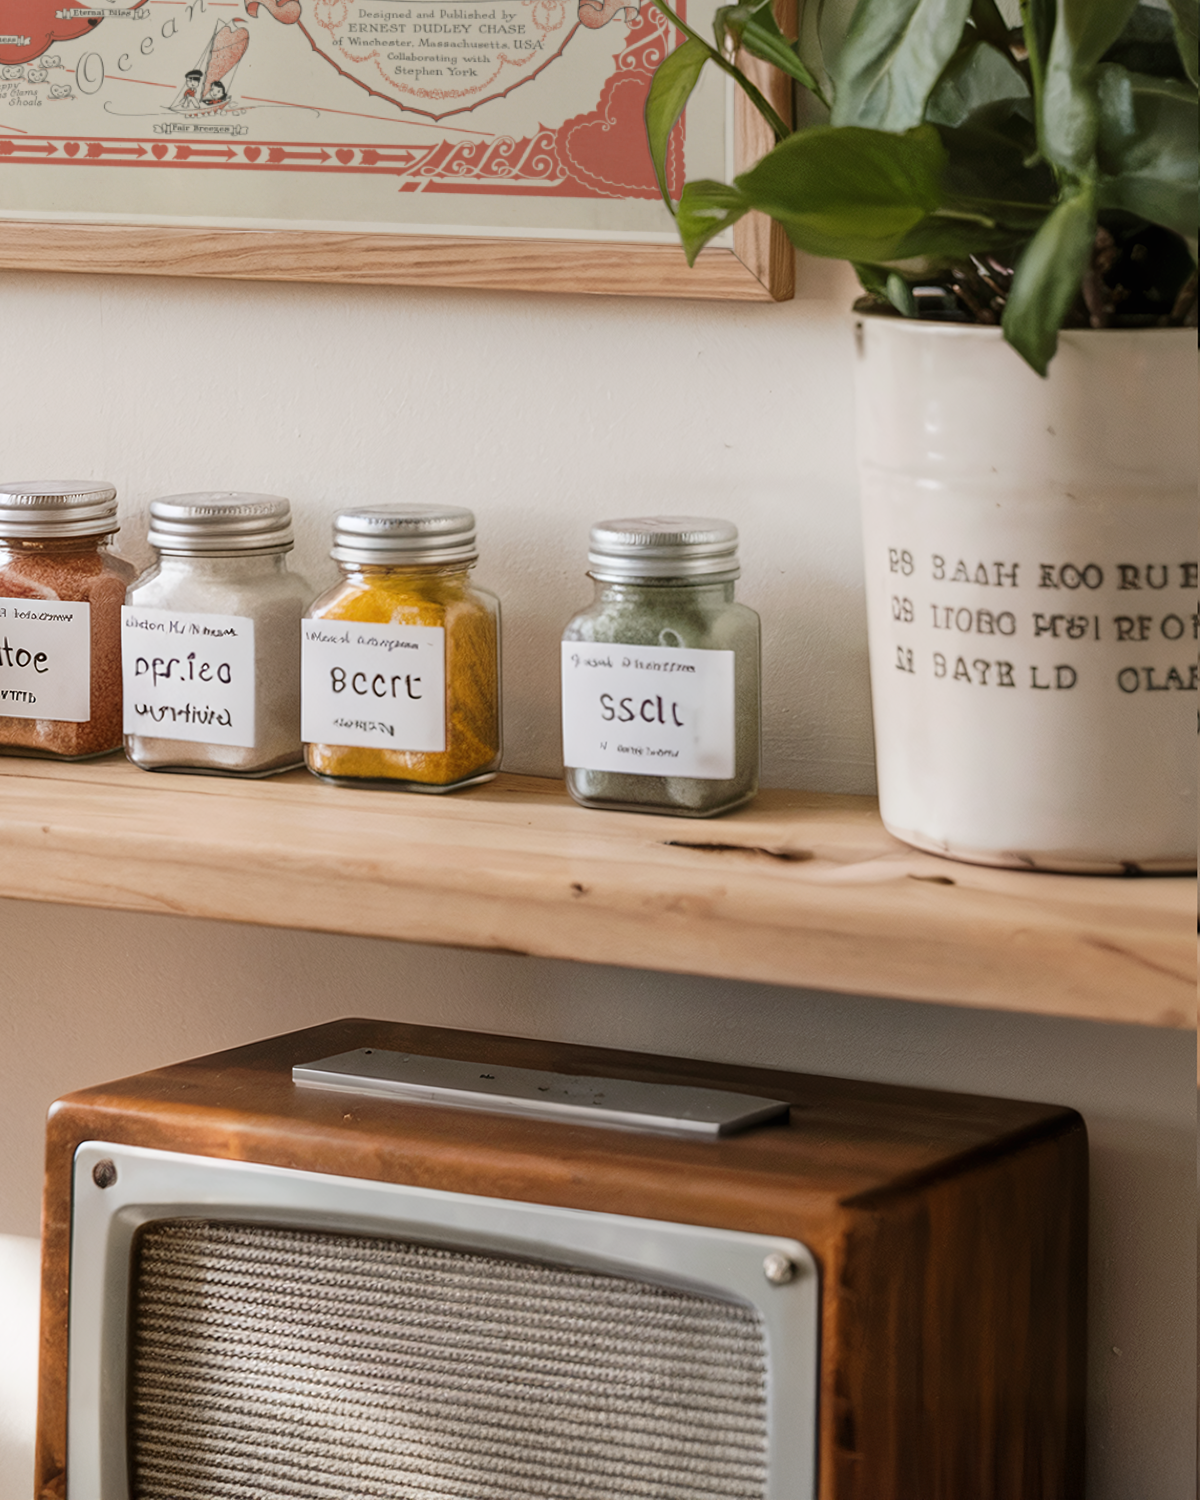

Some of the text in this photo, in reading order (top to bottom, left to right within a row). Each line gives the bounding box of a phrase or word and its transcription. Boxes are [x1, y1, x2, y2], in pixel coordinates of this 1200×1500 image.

[72, 8, 133, 17] Eternal Bliss
[357, 8, 518, 23] Designed and Published by
[347, 22, 527, 35] ERNEST DUDLEY CHASE
[331, 35, 344, 47] of
[386, 51, 491, 65] Collaborating with
[393, 65, 445, 82] Stephen
[9, 88, 39, 98] Clams
[7, 96, 43, 107] Shoals
[172, 122, 230, 134] Fair Breezes
